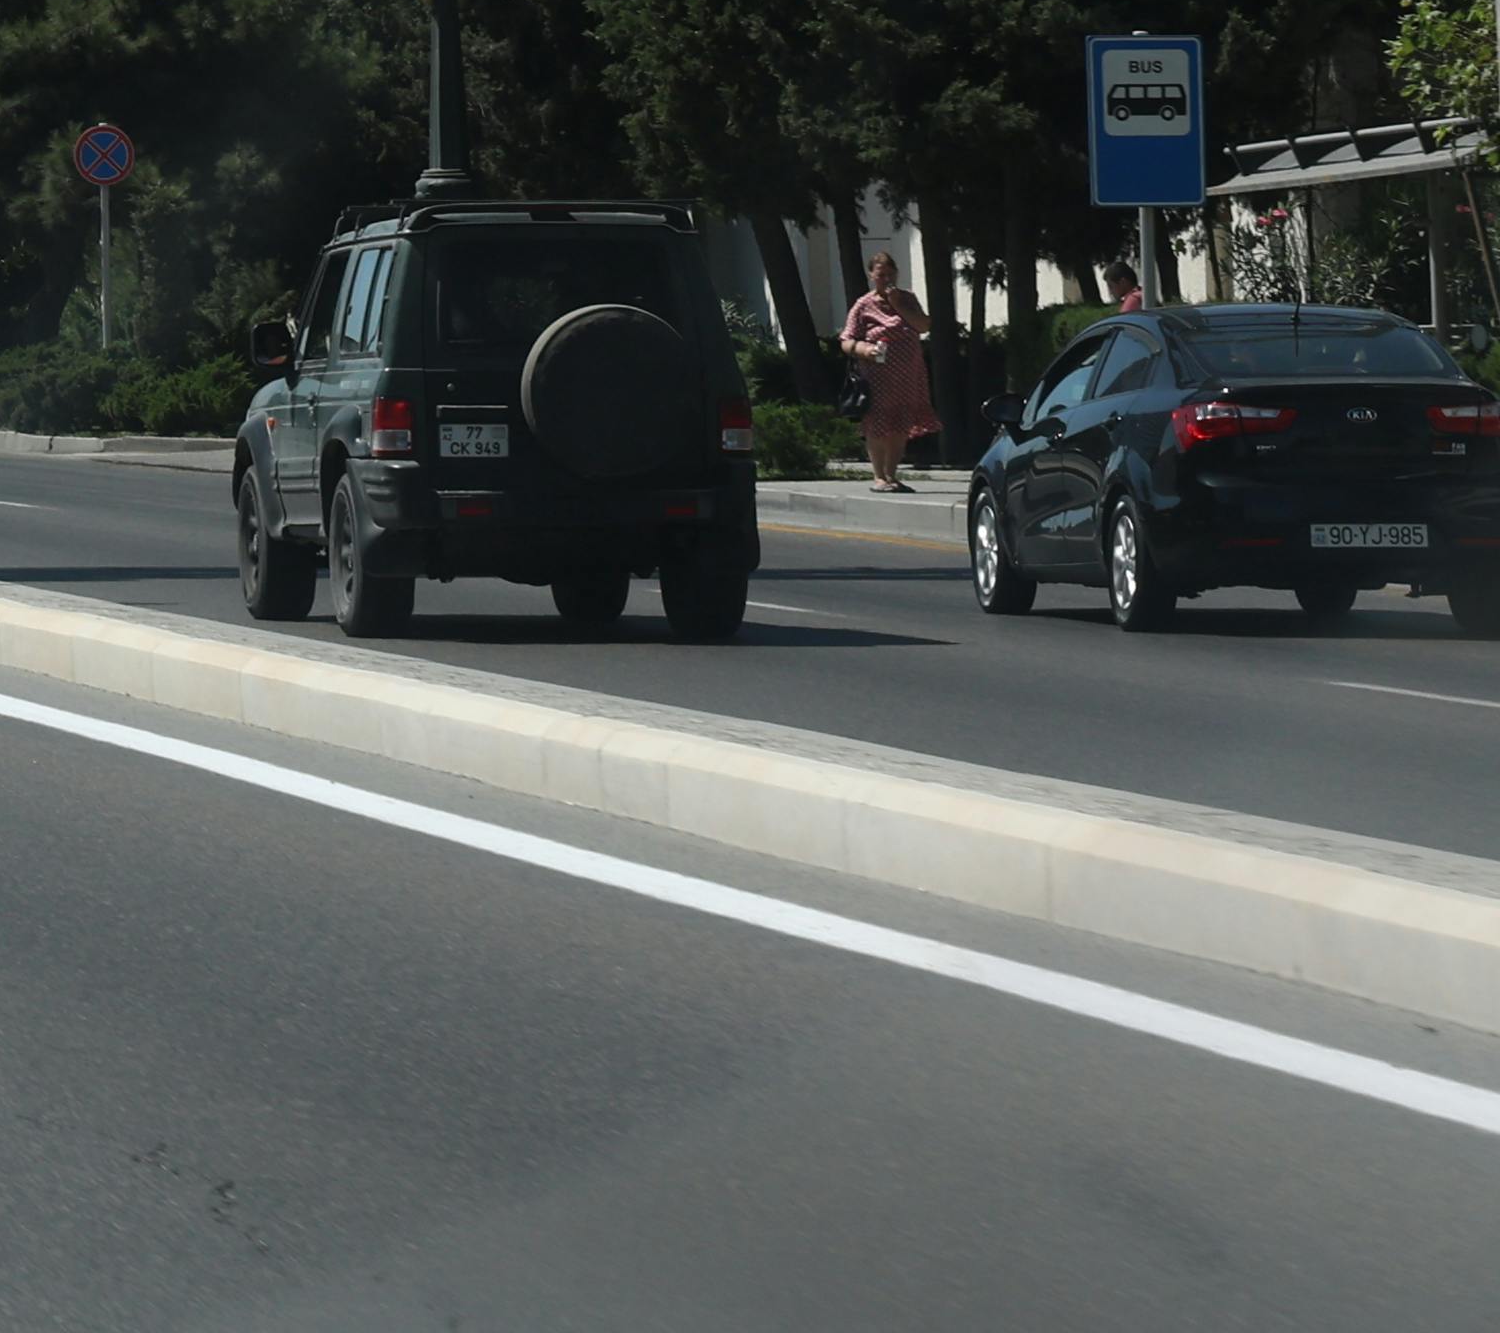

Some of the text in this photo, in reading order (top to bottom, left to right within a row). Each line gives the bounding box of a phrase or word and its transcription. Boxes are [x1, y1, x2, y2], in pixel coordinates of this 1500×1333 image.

[1128, 60, 1163, 74] BUS
[1351, 411, 1374, 420] KIA
[466, 426, 484, 439] 77
[450, 441, 470, 454] CK
[1329, 526, 1424, 546] 90-YJ-985
